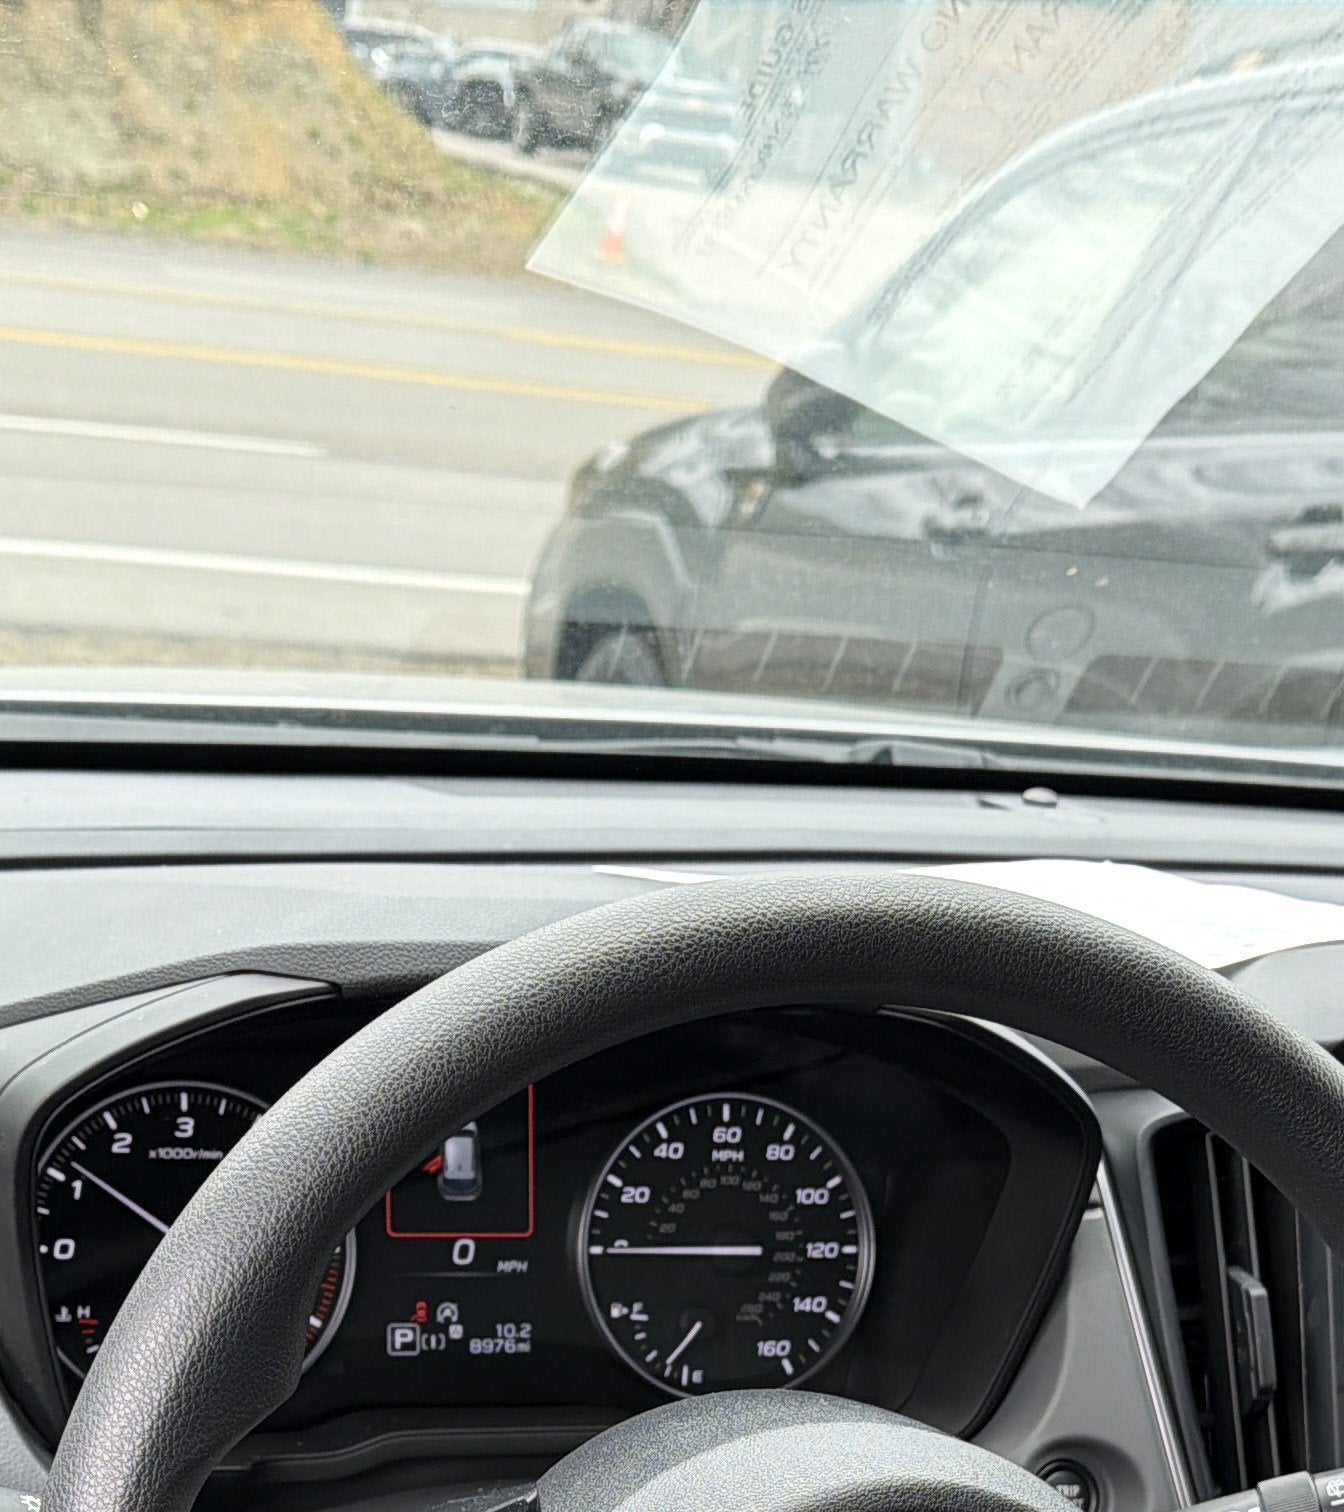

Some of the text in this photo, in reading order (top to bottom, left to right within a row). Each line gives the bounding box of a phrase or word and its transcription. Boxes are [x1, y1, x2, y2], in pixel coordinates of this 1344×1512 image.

[174, 1116, 195, 1138] 3
[712, 1126, 743, 1143] 60
[111, 1132, 133, 1154] 2
[653, 1141, 685, 1160] 40
[765, 1143, 795, 1161] 80
[711, 1150, 745, 1163] MPH
[70, 1179, 83, 1200] 1
[620, 1186, 651, 1204] 20
[795, 1187, 830, 1205] 100
[54, 1238, 76, 1261] 0
[452, 1238, 476, 1266] 0
[806, 1241, 840, 1259] 120
[496, 1259, 529, 1273] MPH
[76, 1304, 91, 1319] H
[793, 1295, 828, 1313] 140
[394, 1328, 414, 1350] P
[495, 1322, 532, 1338] 10.2
[756, 1339, 791, 1357] 160
